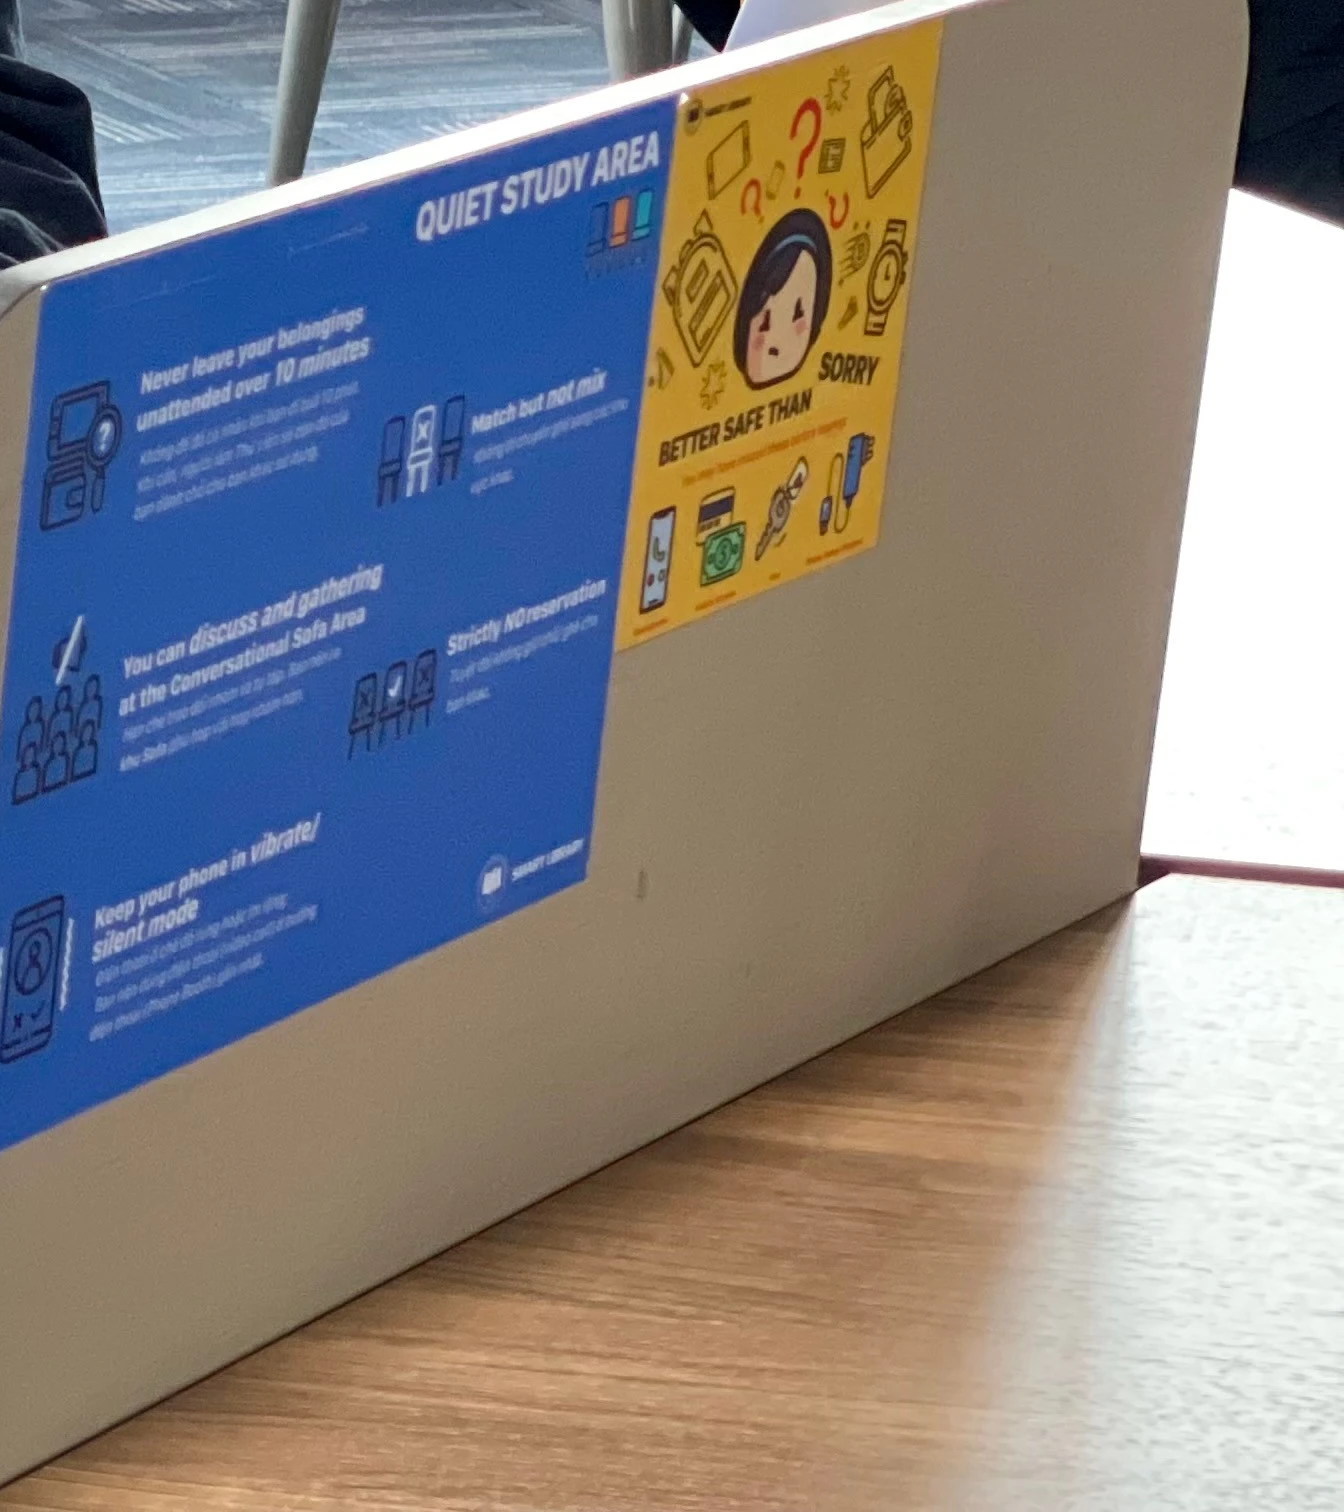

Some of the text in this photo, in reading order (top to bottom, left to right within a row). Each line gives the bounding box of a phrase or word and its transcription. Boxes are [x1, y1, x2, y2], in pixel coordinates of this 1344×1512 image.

[416, 131, 659, 241] QUIET STUDY AREA
[137, 337, 370, 431] unattended over 10 minutes
[141, 307, 365, 395] Never leave your belongings
[818, 352, 880, 385] SORRY
[470, 367, 607, 434] Match but not mix
[659, 422, 720, 467] BETTER
[724, 404, 766, 442] SAFE
[768, 388, 813, 425] THAN
[119, 606, 366, 716] at the Conversational Sofa Area
[123, 562, 384, 679] You can discuss and gathering
[446, 619, 504, 656] Strictly
[95, 812, 321, 929] Keep your phone in vibrate/
[92, 898, 199, 965] silent mode
